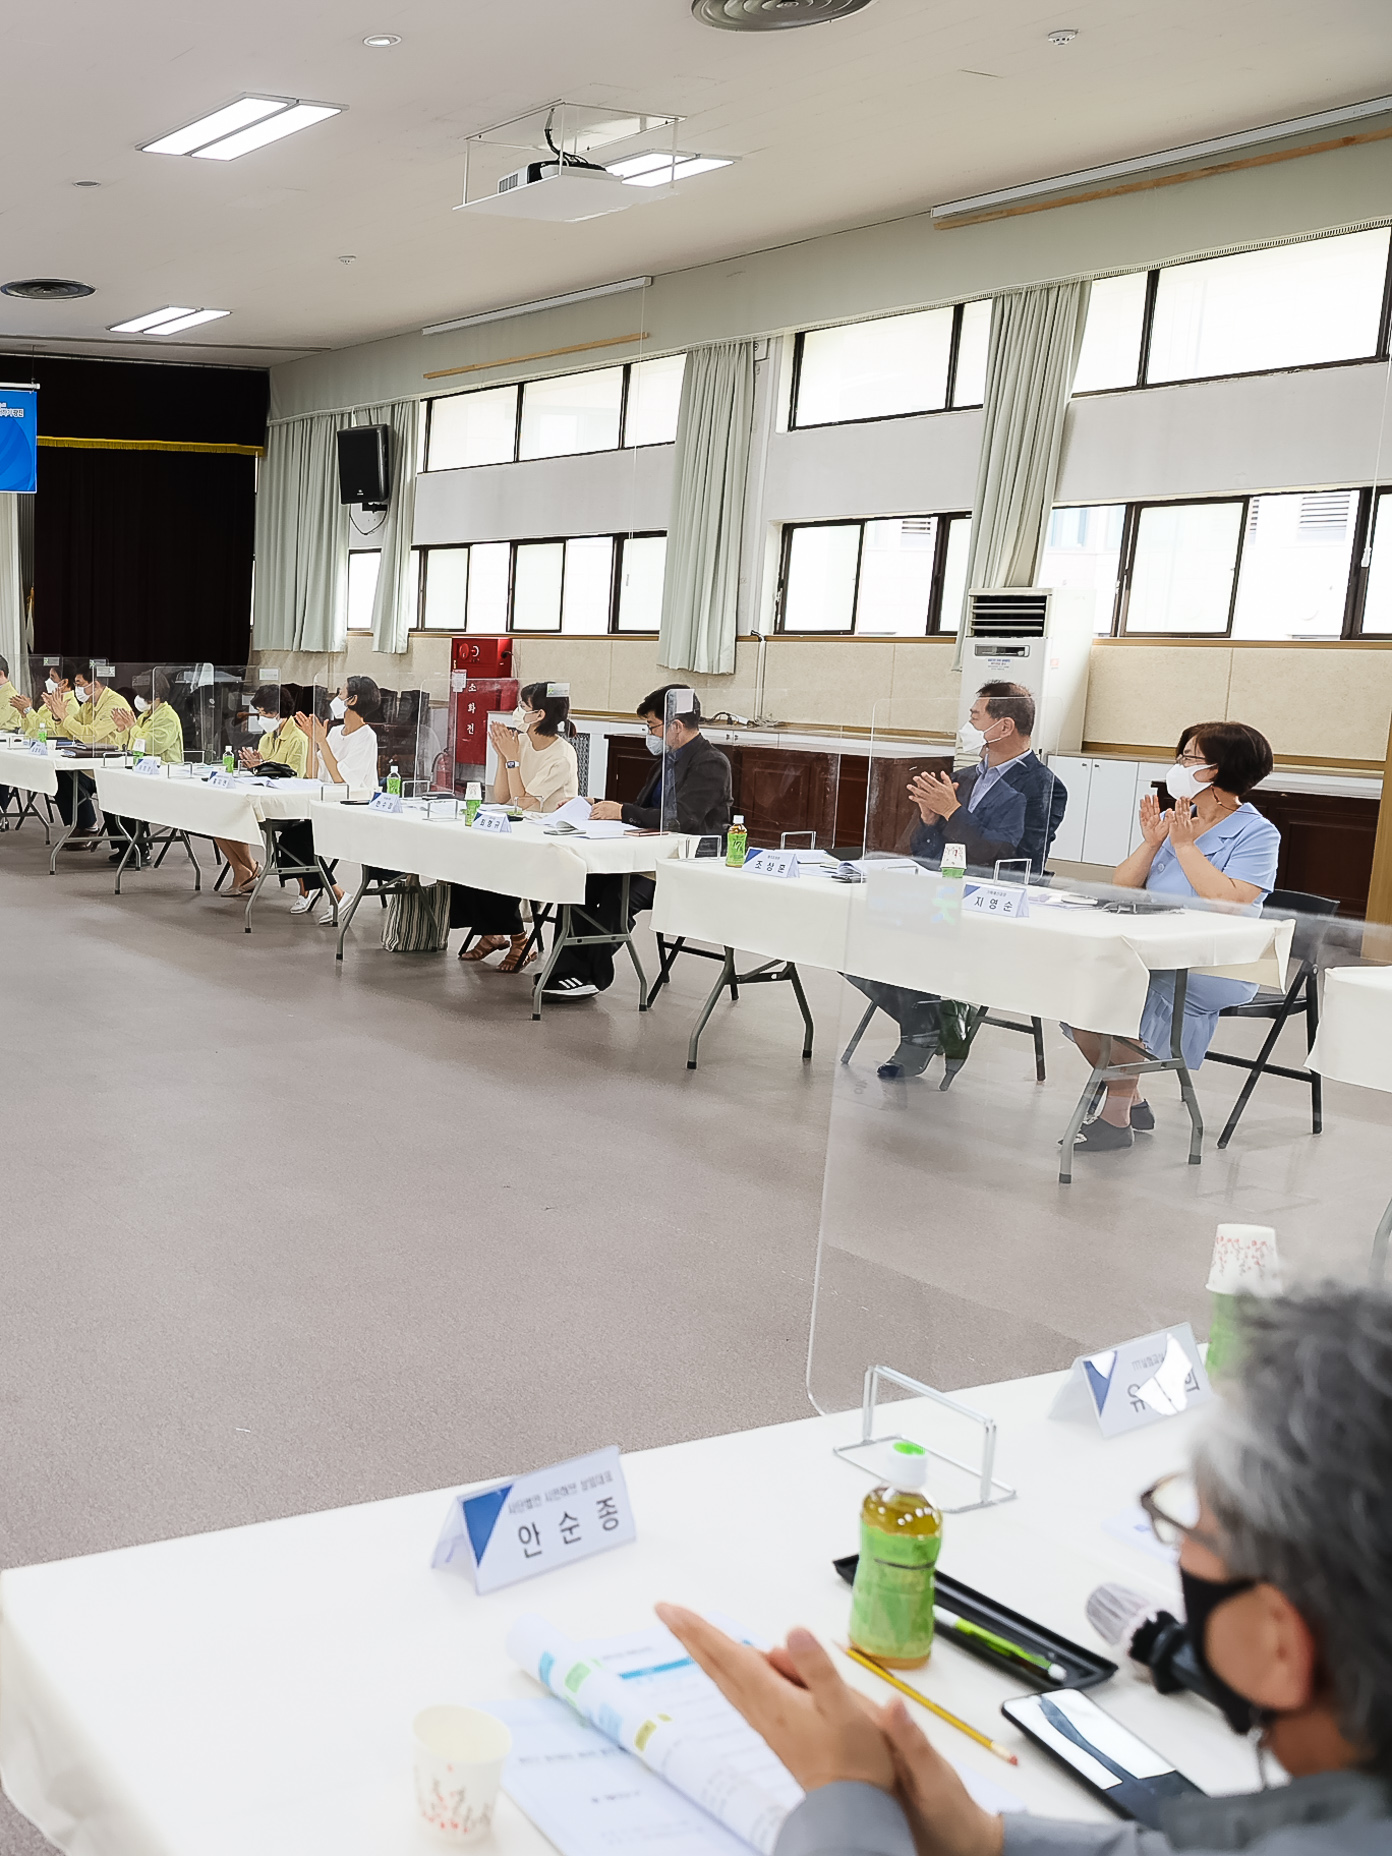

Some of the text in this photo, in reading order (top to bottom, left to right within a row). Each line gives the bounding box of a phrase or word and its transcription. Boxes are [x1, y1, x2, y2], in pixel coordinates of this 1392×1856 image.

[467, 683, 477, 735] 소화전
[974, 896, 1013, 912] 지영순
[518, 1496, 620, 1559] 안순종
